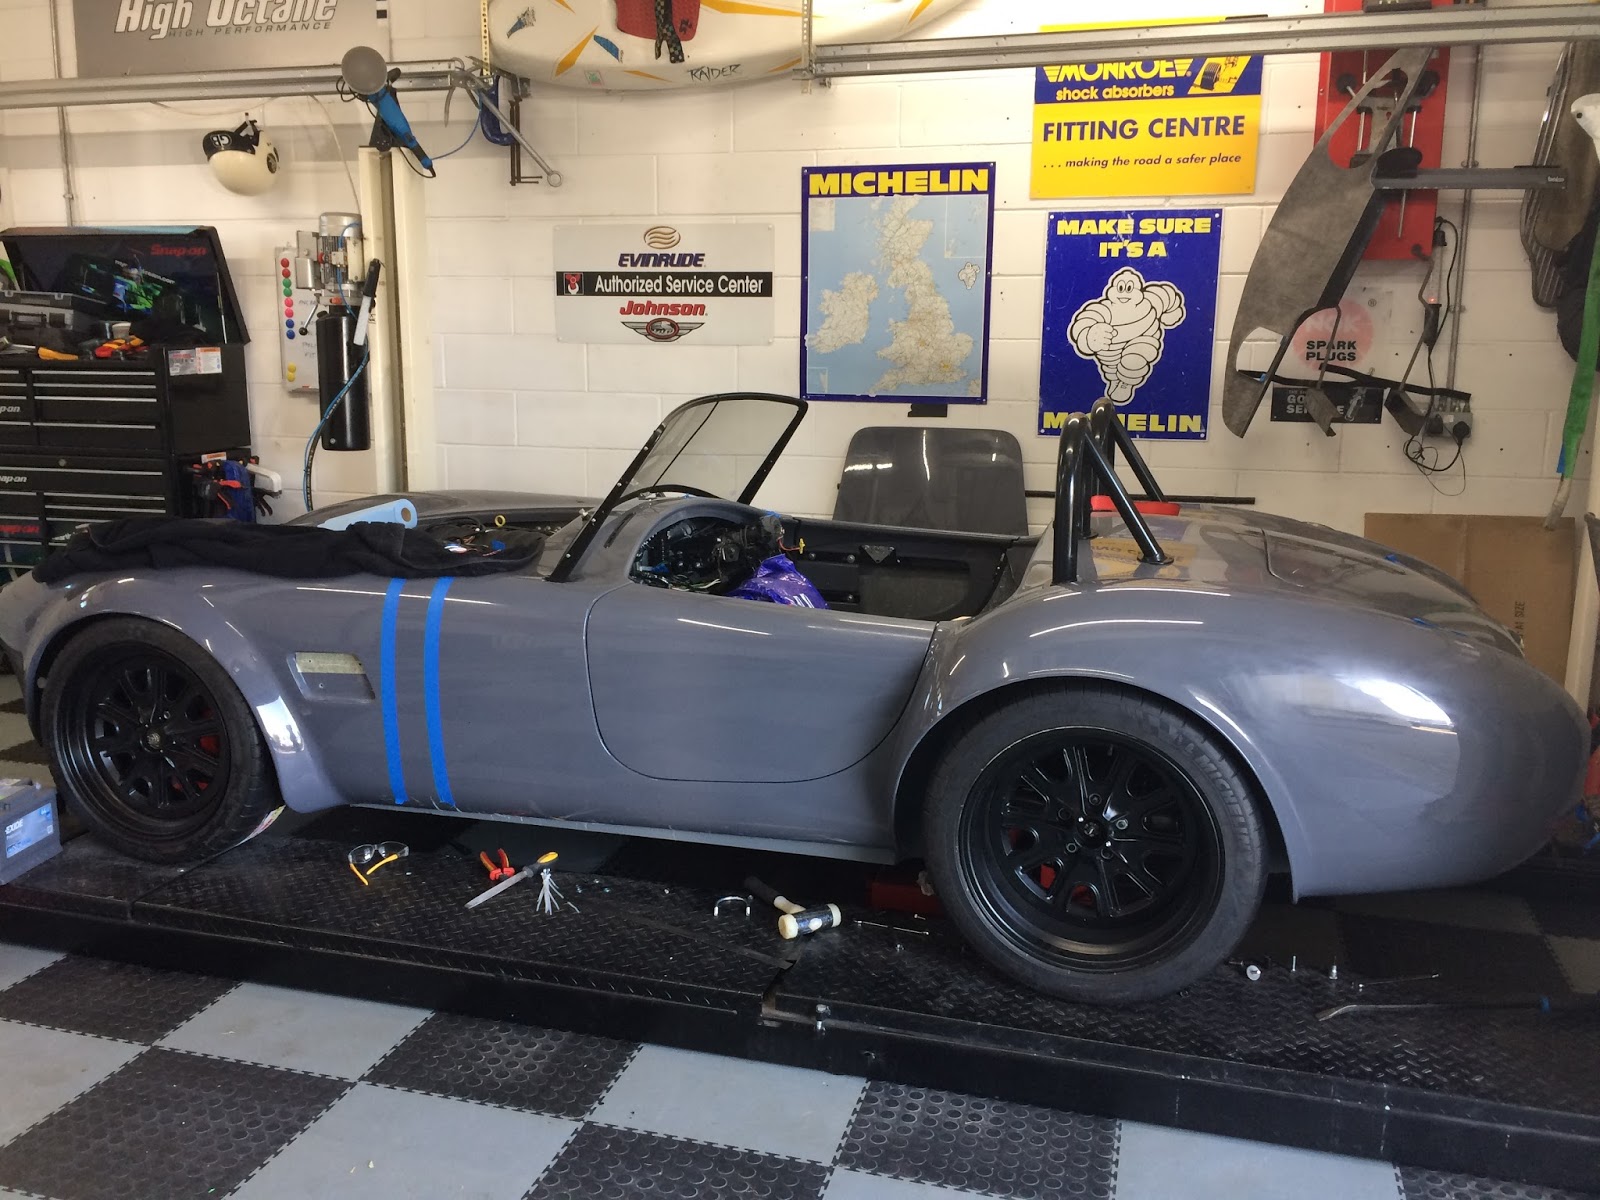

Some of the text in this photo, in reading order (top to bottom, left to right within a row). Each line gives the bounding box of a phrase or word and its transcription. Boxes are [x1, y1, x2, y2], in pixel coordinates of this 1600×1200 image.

[114, 0, 338, 40] High Octane
[169, 21, 332, 37] HIGH PERFORMANCE
[687, 64, 741, 81] RAIDER
[1056, 84, 1174, 101] shock absorbers
[1043, 115, 1245, 142] FITTING CENTRE
[1065, 157, 1108, 169] making
[1112, 156, 1130, 166] the
[1134, 155, 1161, 166] road
[1176, 154, 1206, 165] safer
[1209, 153, 1241, 166] place
[809, 168, 989, 196] MICHELIN
[1057, 217, 1211, 236] MAKE SURE
[1099, 239, 1168, 258] IT'S A
[618, 253, 706, 268] EVINRUDE
[595, 275, 763, 293] Authorized Service Center
[619, 300, 706, 316] Johnson
[1306, 340, 1357, 350] SPARK
[1305, 351, 1356, 361] PLUGS
[1043, 412, 1203, 433] MELIN
